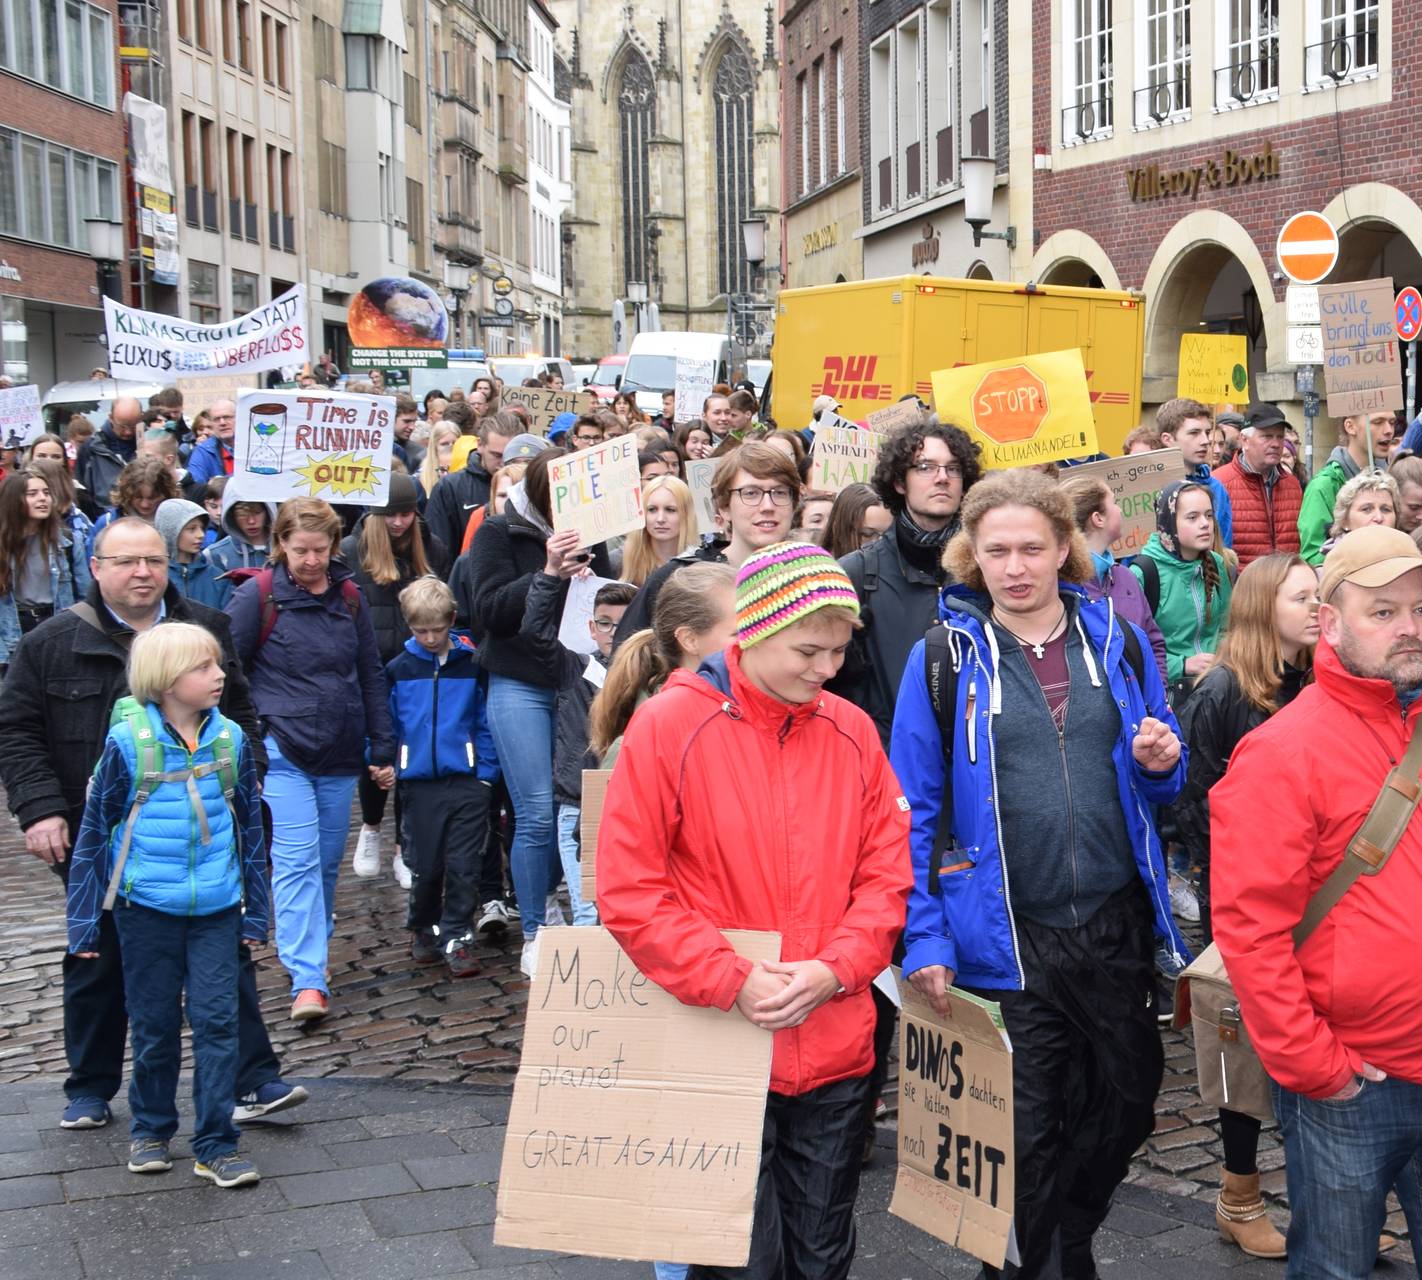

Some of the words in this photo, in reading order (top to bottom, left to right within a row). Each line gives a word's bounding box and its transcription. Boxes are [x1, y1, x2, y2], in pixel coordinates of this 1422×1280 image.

[1126, 164, 1202, 201] Villeroy
[1206, 159, 1220, 188] &
[1224, 140, 1279, 186] Boch
[1322, 292, 1372, 315] Gülle
[114, 309, 248, 343] KLIMASCHUTZ
[251, 295, 299, 331] STATT
[1326, 316, 1370, 346] bringt
[1373, 322, 1393, 336] uns
[175, 351, 211, 371] UND
[352, 349, 388, 357] CHANGE
[407, 350, 445, 359] SYSTEM,
[352, 358, 370, 366] NOT
[1328, 350, 1350, 367] den
[1349, 341, 1394, 364] Tod!
[822, 356, 880, 399] DHL
[296, 397, 357, 424] Time
[367, 402, 389, 427] is
[501, 388, 540, 410] Keine
[545, 390, 578, 414] Zeit
[295, 424, 382, 451] RUNNING
[820, 442, 868, 458] ASPHALT
[314, 464, 370, 484] OUT!
[552, 449, 608, 482] RETTET
[1107, 470, 1119, 481] ich
[541, 947, 648, 1010] Make
[553, 1025, 600, 1051] our
[536, 1043, 624, 1114] planet
[906, 1022, 964, 1100] DINOS
[970, 1074, 1006, 1113] dachten
[904, 1081, 915, 1103] sie
[924, 1088, 950, 1119] hätten
[523, 1130, 611, 1169] GREAT
[904, 1125, 925, 1159] noch
[934, 1122, 1005, 1208] ZEIT
